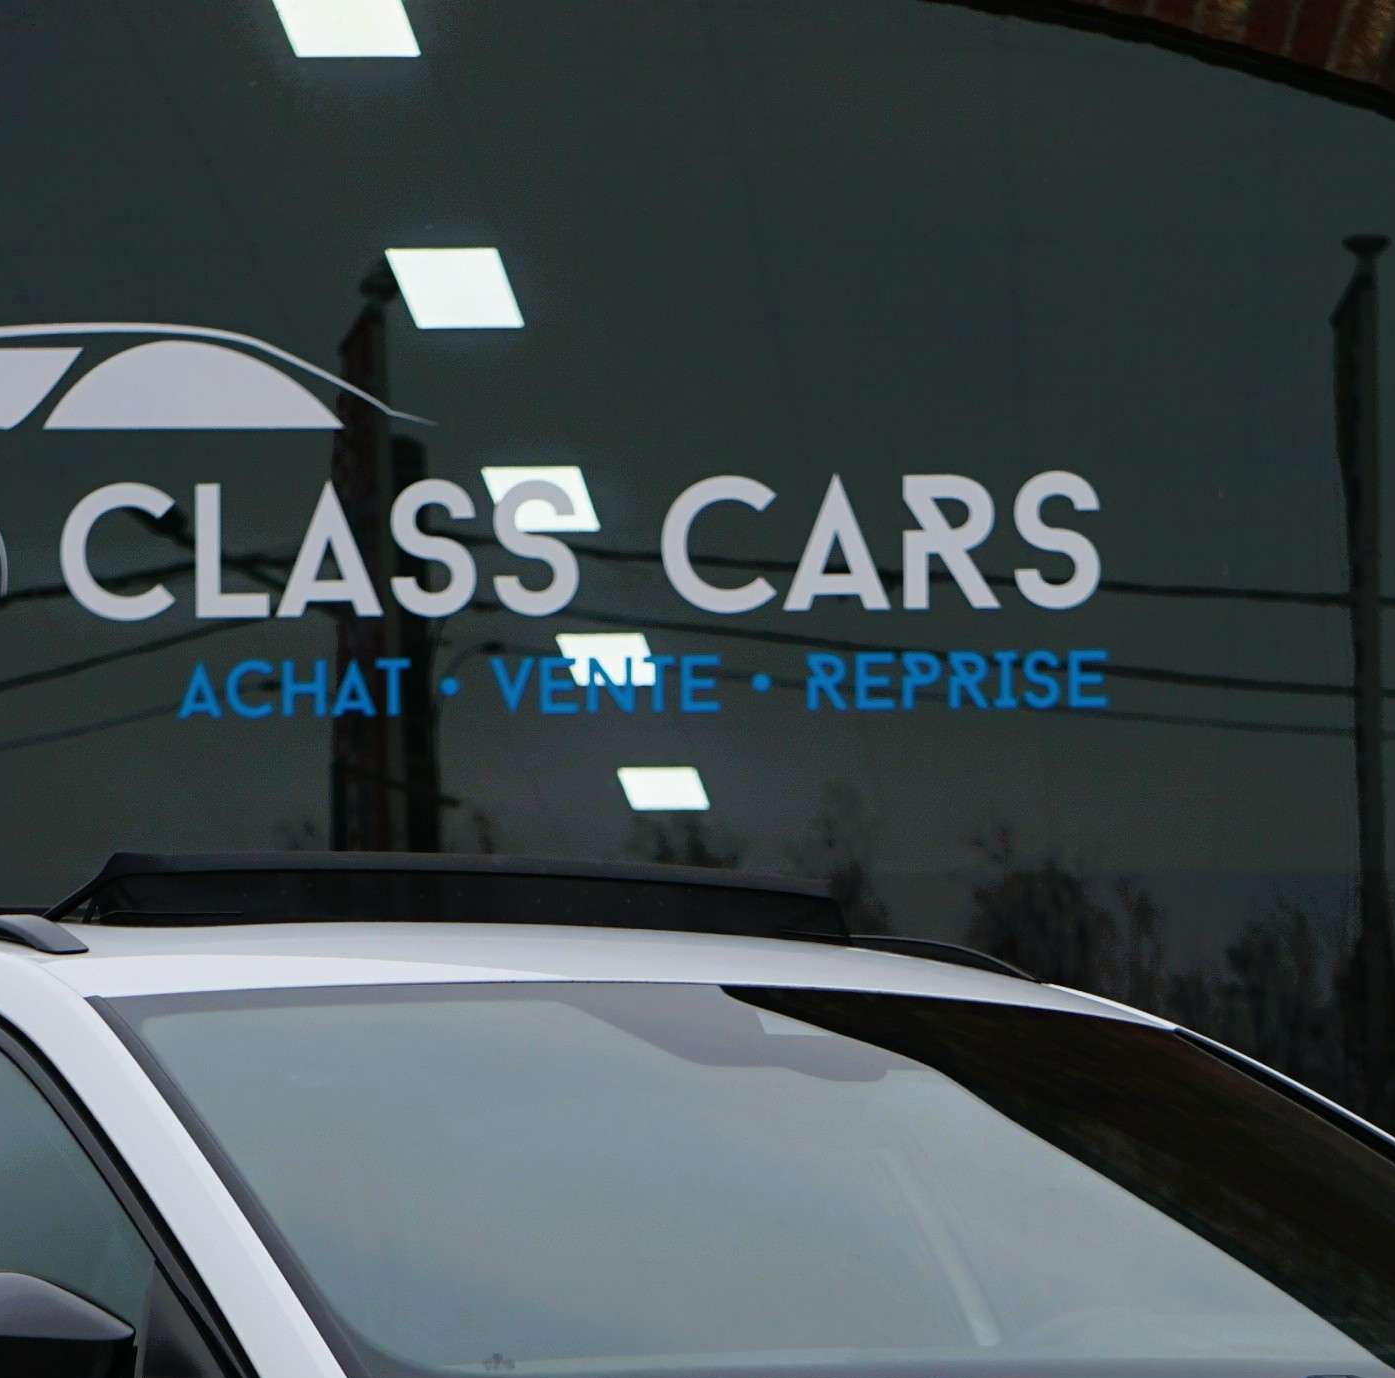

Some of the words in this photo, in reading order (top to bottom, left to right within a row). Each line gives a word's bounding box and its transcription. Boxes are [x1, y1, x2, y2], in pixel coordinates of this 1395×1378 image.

[60, 479, 580, 622] CLASS
[660, 469, 1101, 615] CARS
[178, 657, 412, 719] ACHAT
[491, 655, 722, 715] VENTE
[806, 648, 1110, 712] REPRISE
